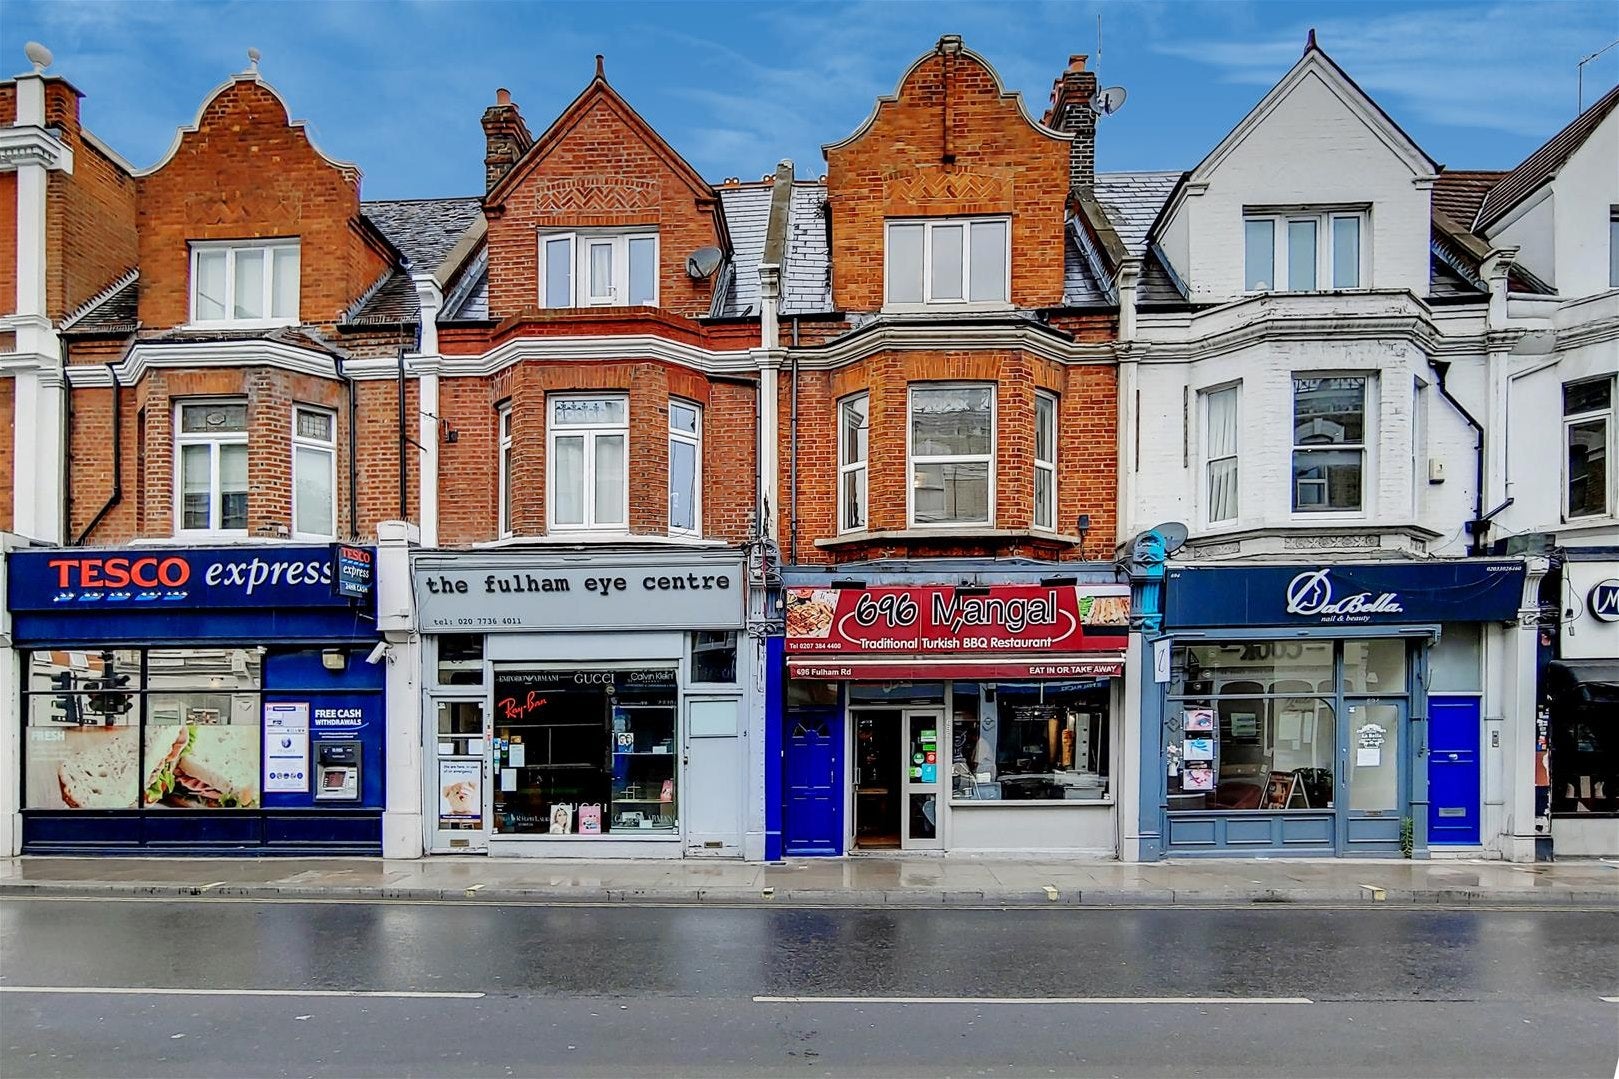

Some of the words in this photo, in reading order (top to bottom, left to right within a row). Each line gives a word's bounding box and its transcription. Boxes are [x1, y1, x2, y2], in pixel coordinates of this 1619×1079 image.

[341, 547, 370, 563] TESCO
[49, 556, 190, 588] TESCO
[205, 557, 330, 595] express
[343, 565, 369, 578] express
[426, 576, 468, 593] the
[484, 575, 570, 592] fulham
[584, 575, 627, 595] eye
[642, 572, 730, 590] centre
[854, 592, 919, 627] 696
[932, 591, 1057, 633] Mangal
[434, 618, 453, 626] tel:
[478, 617, 498, 625] 7736
[1346, 614, 1370, 623] beauty
[860, 638, 918, 649] Traditional
[922, 637, 959, 649] Turkish
[963, 638, 988, 649] BBQ
[990, 637, 1052, 648] Restaurant
[631, 672, 654, 680] Calvin
[655, 671, 674, 680] Klein
[1030, 666, 1044, 674] EAT
[1046, 666, 1055, 674] IN
[1093, 665, 1117, 673] AWAY
[574, 673, 615, 684] GUCCI
[498, 691, 547, 718] Ray-Ban
[315, 709, 336, 718] FREE
[337, 709, 361, 717] CASH
